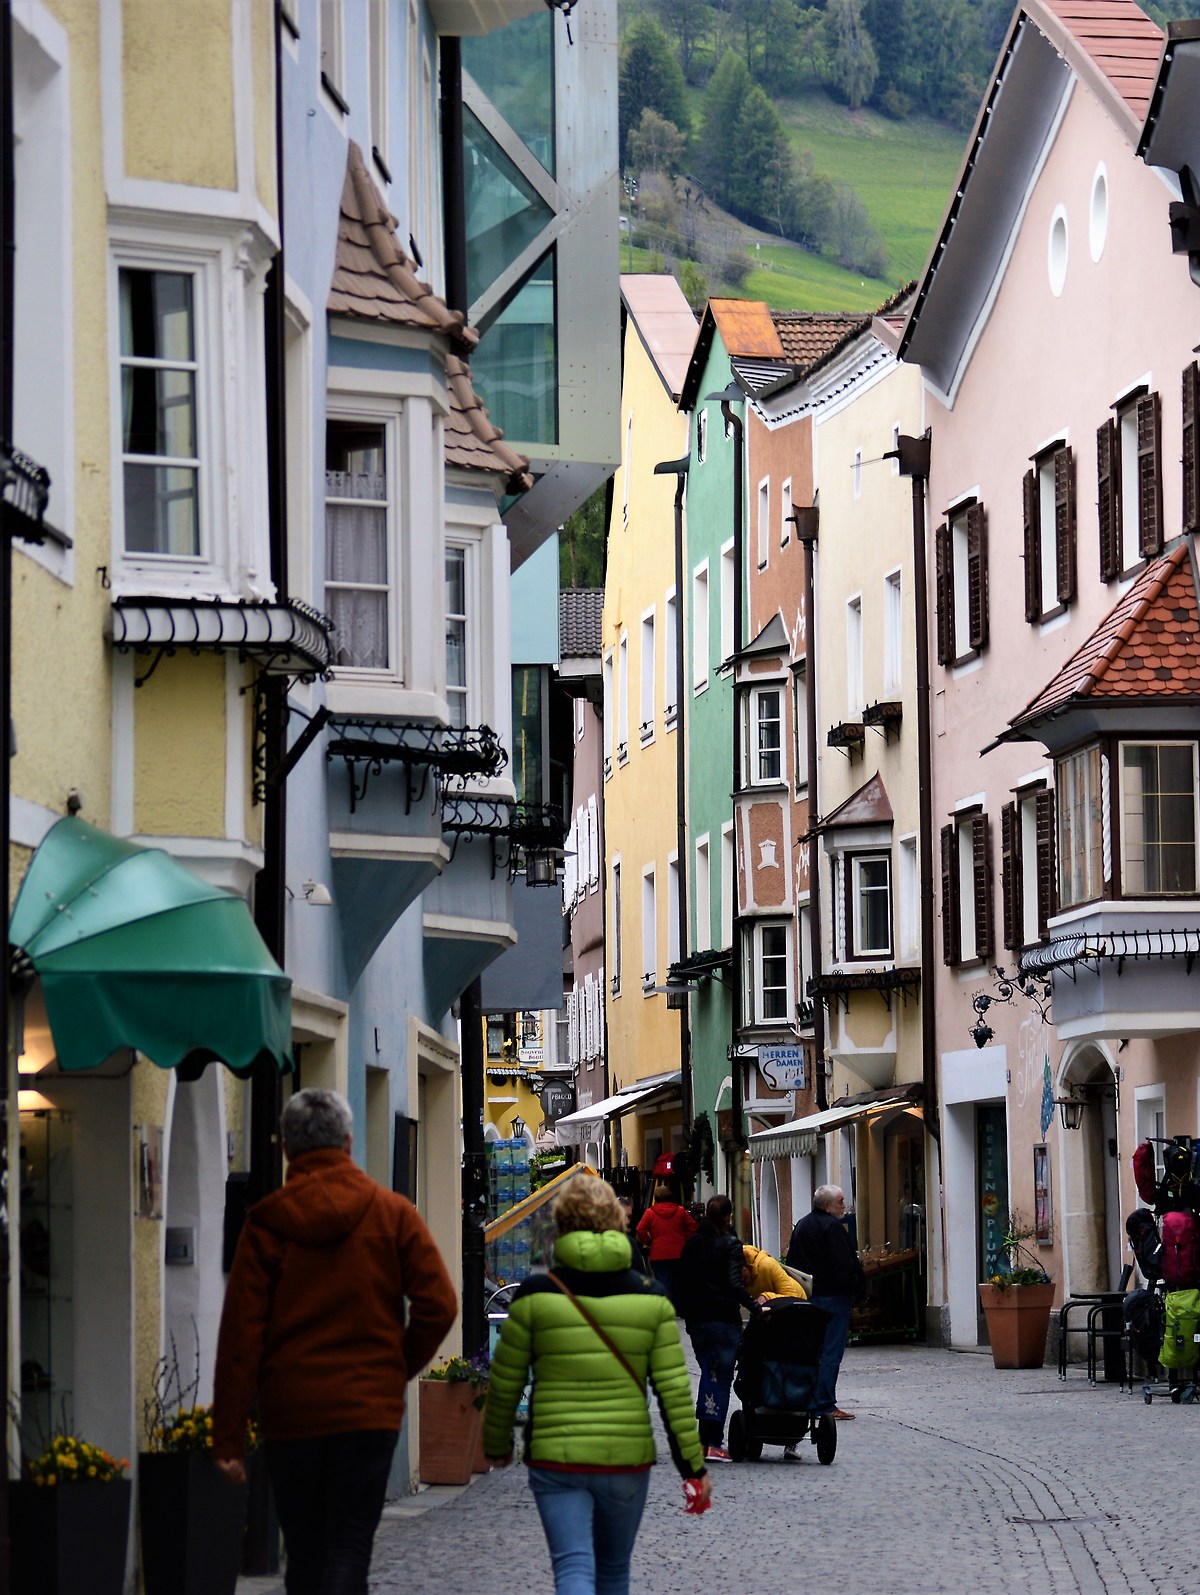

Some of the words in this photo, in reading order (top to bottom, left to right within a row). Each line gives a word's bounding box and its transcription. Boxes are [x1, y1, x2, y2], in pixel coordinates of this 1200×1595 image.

[762, 1050, 799, 1059] HERREN
[776, 1059, 803, 1067] DAMEN
[984, 1123, 996, 1191] BETTEN
